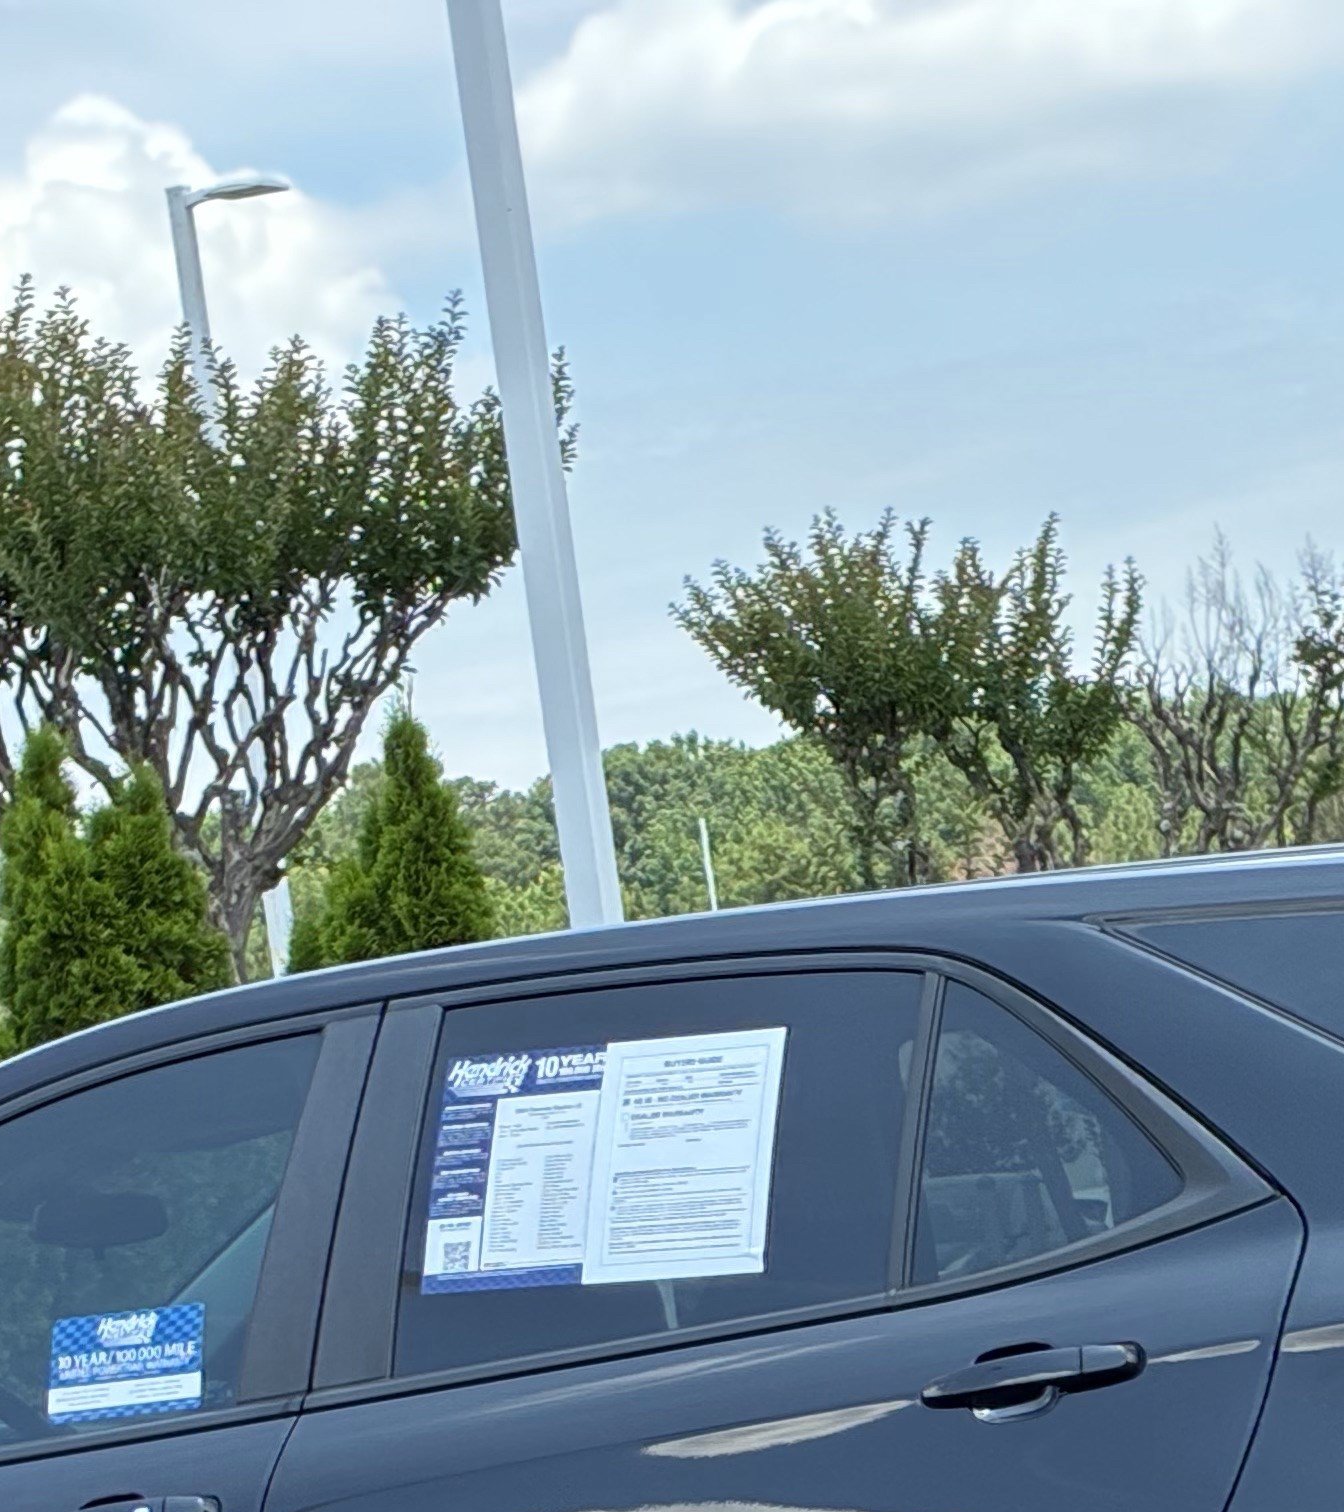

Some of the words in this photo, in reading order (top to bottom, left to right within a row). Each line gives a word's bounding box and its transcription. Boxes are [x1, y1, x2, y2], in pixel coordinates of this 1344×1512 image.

[447, 1054, 533, 1093] Hendrick
[535, 1055, 559, 1079] 10
[163, 1340, 198, 1357] MILE
